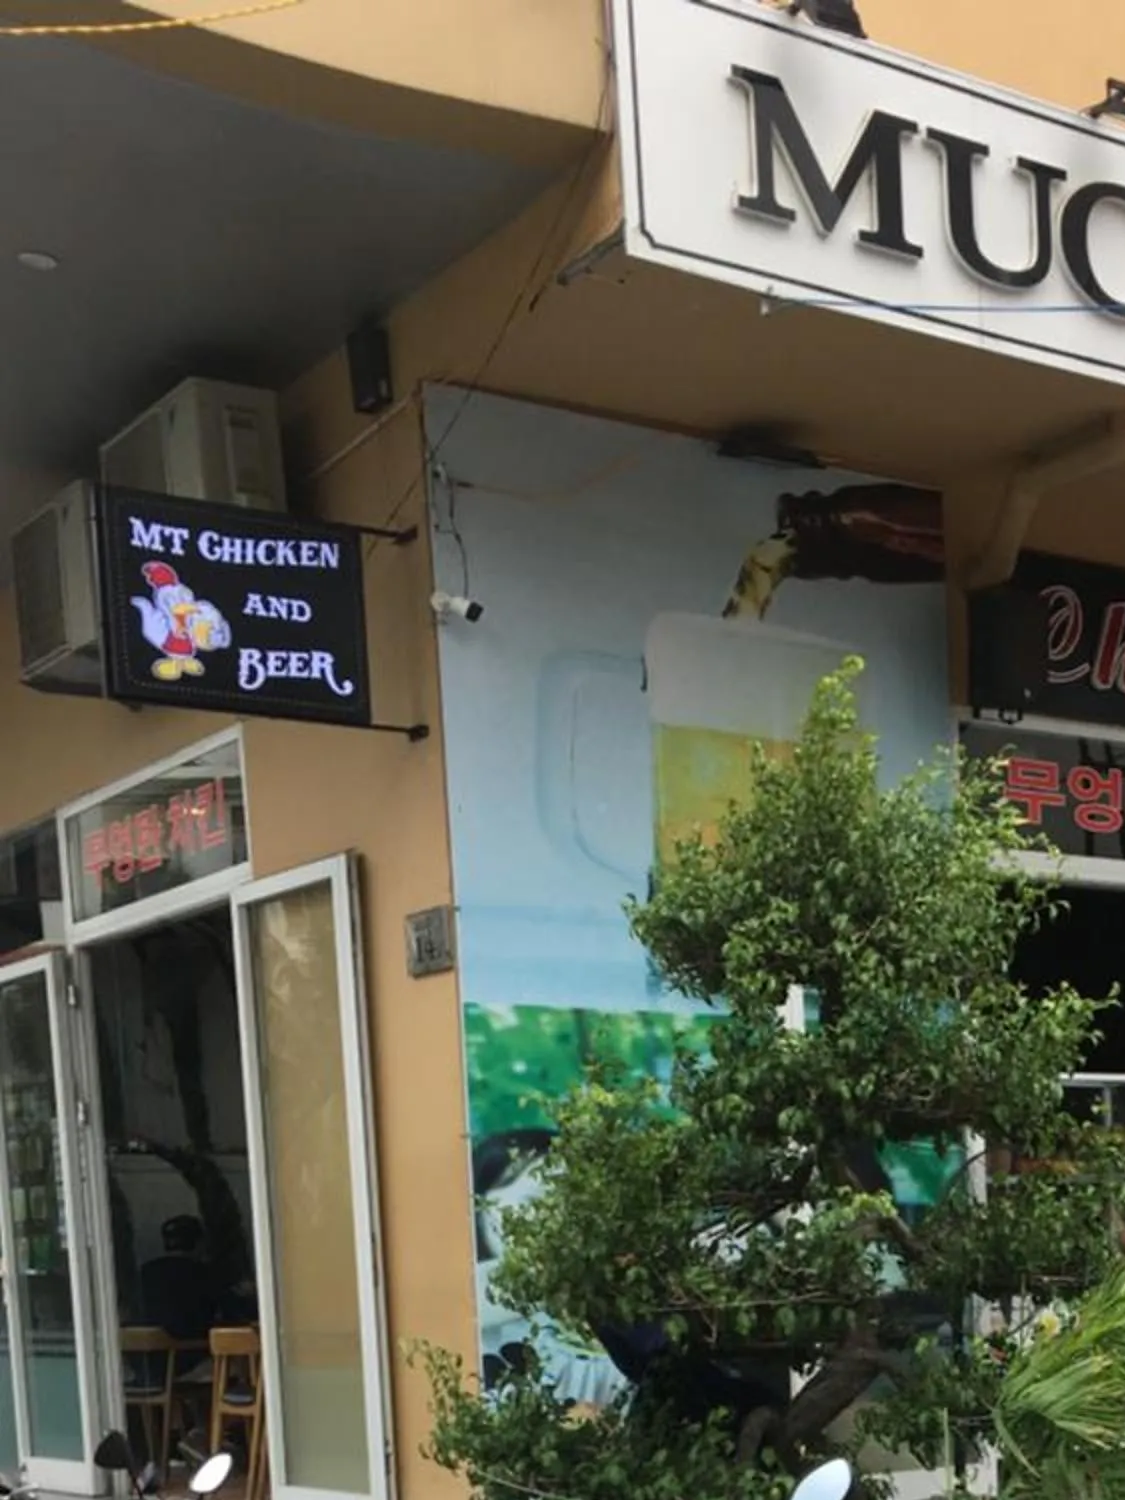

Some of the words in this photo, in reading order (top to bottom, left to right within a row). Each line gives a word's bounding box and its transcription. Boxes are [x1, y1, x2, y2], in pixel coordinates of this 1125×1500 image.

[129, 515, 189, 557] MT
[197, 530, 340, 569] CHICKEN
[242, 592, 312, 622] AND
[237, 647, 354, 697] BEER
